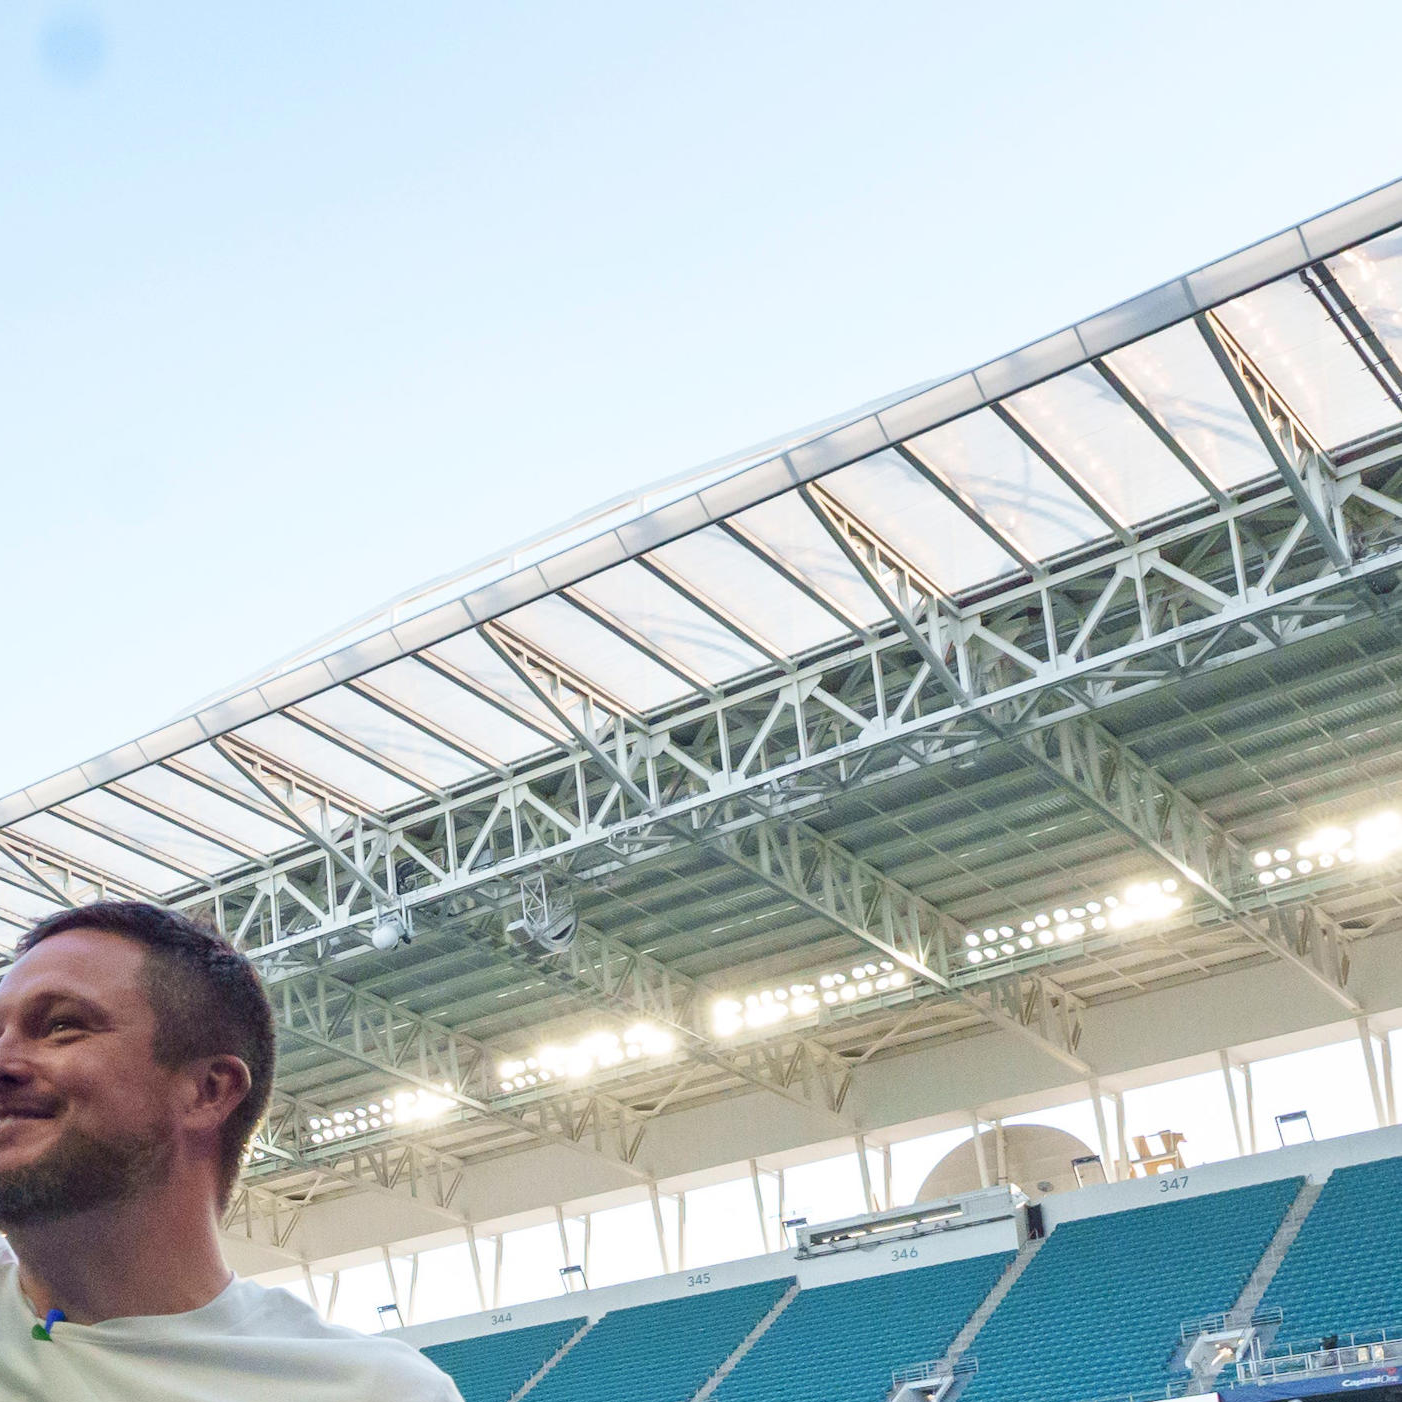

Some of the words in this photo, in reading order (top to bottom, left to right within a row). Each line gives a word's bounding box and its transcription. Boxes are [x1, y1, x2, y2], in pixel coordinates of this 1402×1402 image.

[1159, 1175, 1189, 1193] 347
[891, 1246, 919, 1262] 346
[687, 1272, 712, 1288] 345
[491, 1312, 513, 1326] 344
